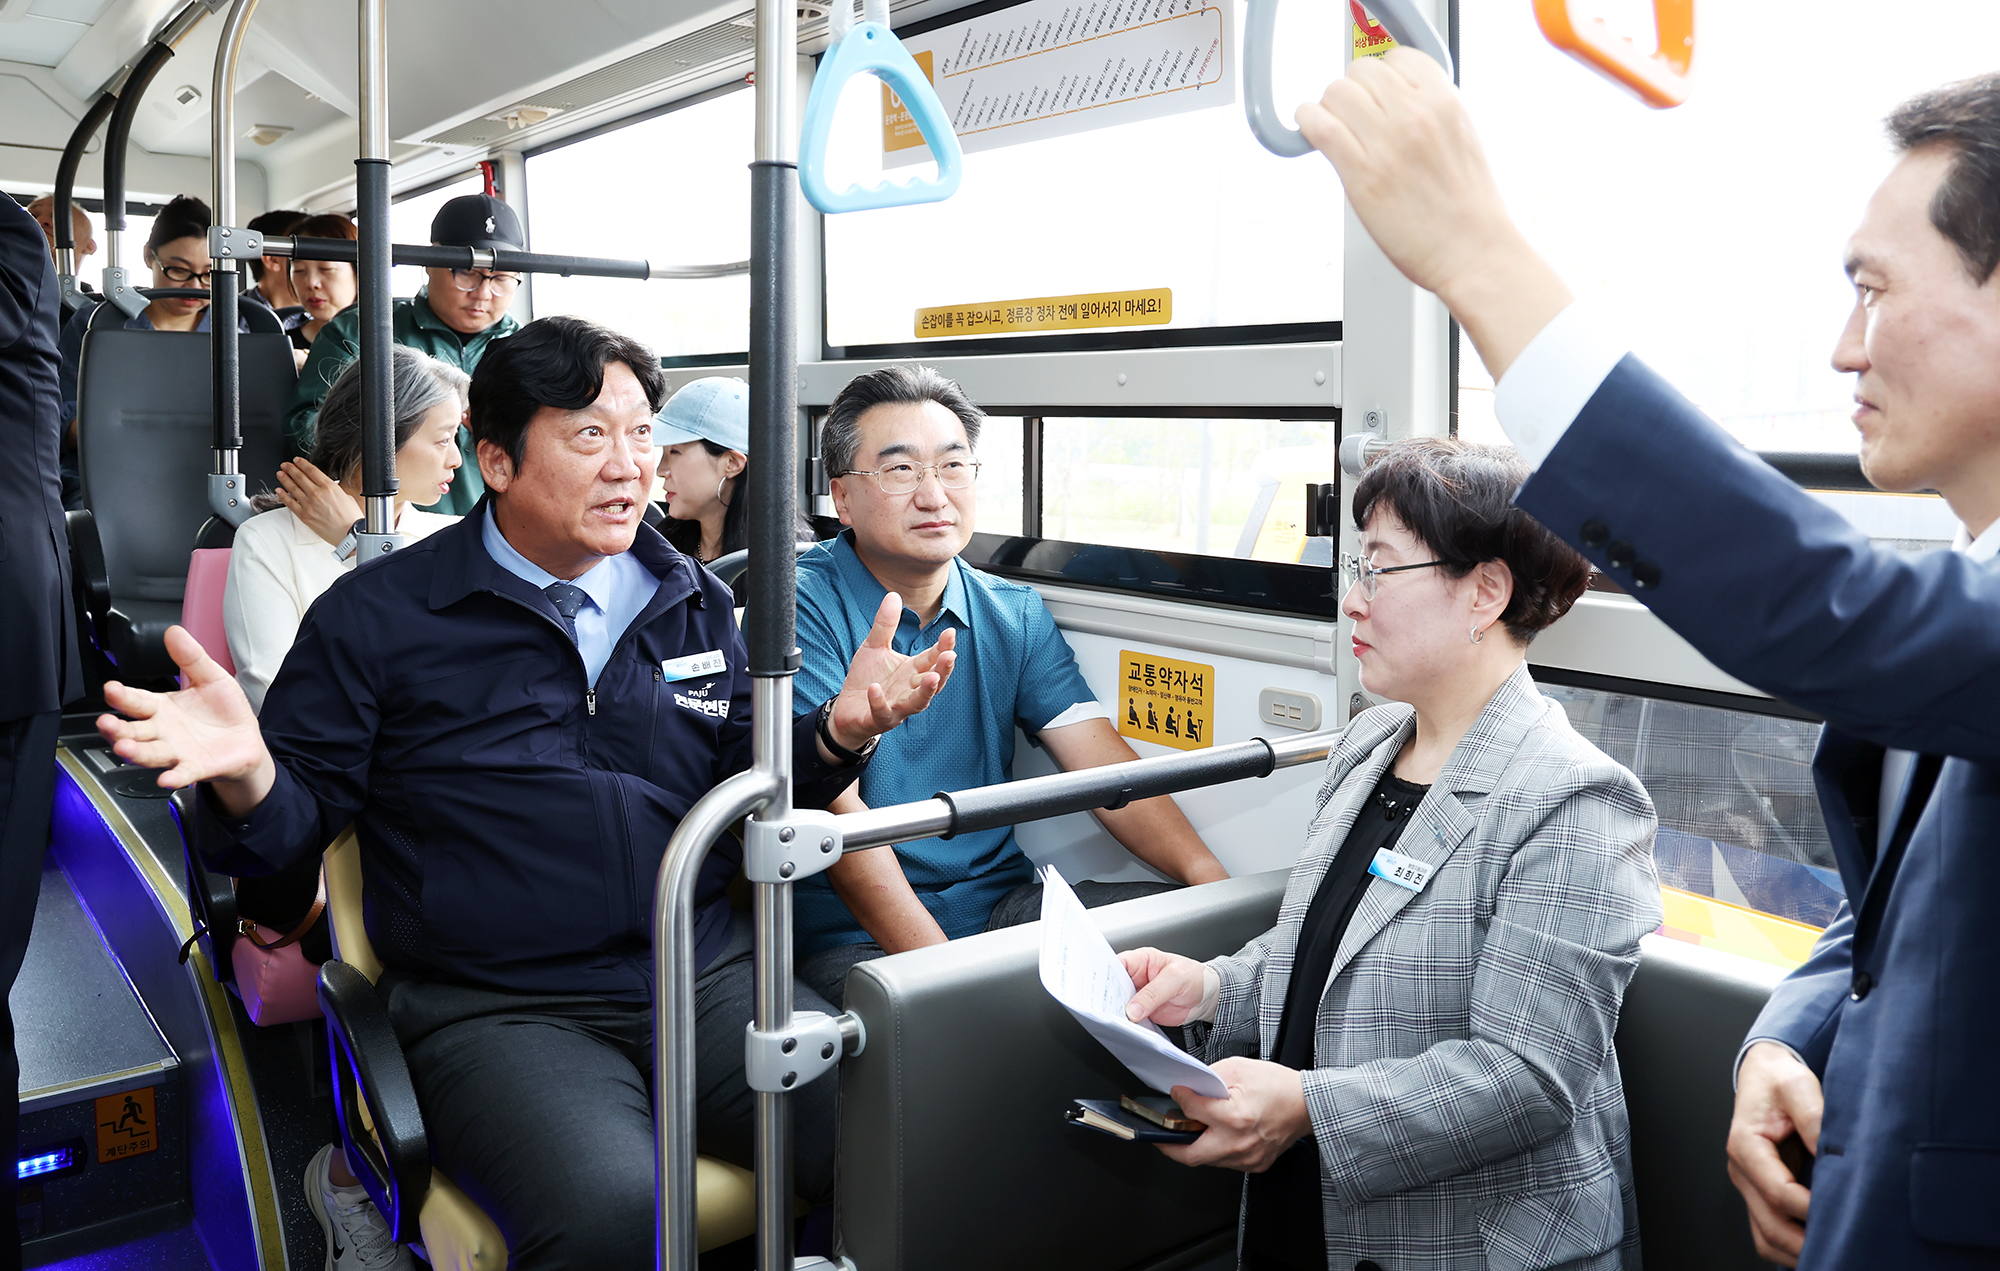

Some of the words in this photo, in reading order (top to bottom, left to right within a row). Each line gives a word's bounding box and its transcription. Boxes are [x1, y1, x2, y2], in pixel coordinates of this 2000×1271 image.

[922, 312, 953, 329] 손잡이를
[956, 312, 965, 327] 꼭
[967, 309, 1003, 326] 잡으시고,
[1006, 307, 1033, 323] 정류장
[1036, 306, 1056, 321] 정차
[1058, 303, 1077, 320] 전에
[1080, 300, 1121, 319] 일어서지
[1125, 298, 1162, 316] 마세요!
[1128, 661, 1203, 697] 교통약자석
[687, 689, 709, 698] PAJU
[1394, 866, 1424, 885] 최희진
[105, 1138, 150, 1157] 계단주의
